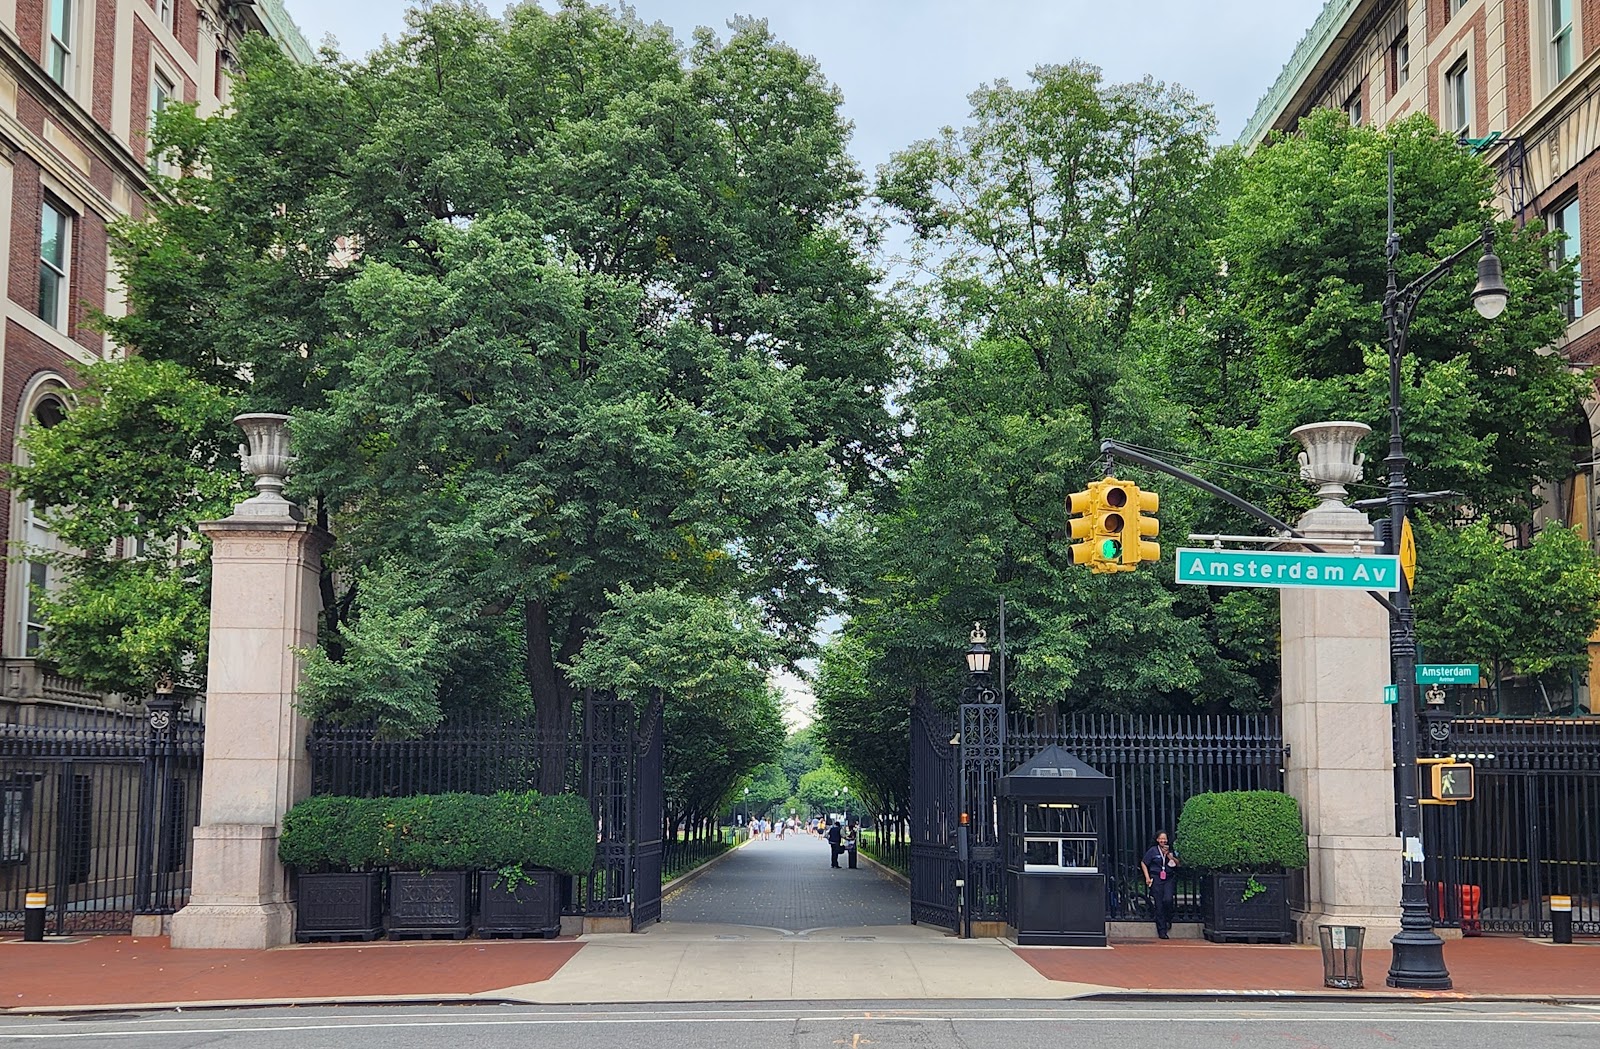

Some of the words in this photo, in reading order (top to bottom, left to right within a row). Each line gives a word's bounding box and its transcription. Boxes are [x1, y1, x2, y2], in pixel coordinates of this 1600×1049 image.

[1188, 558, 1344, 581] Amsterdam
[1352, 563, 1387, 581] Av
[1422, 666, 1472, 676] Amsterdam
